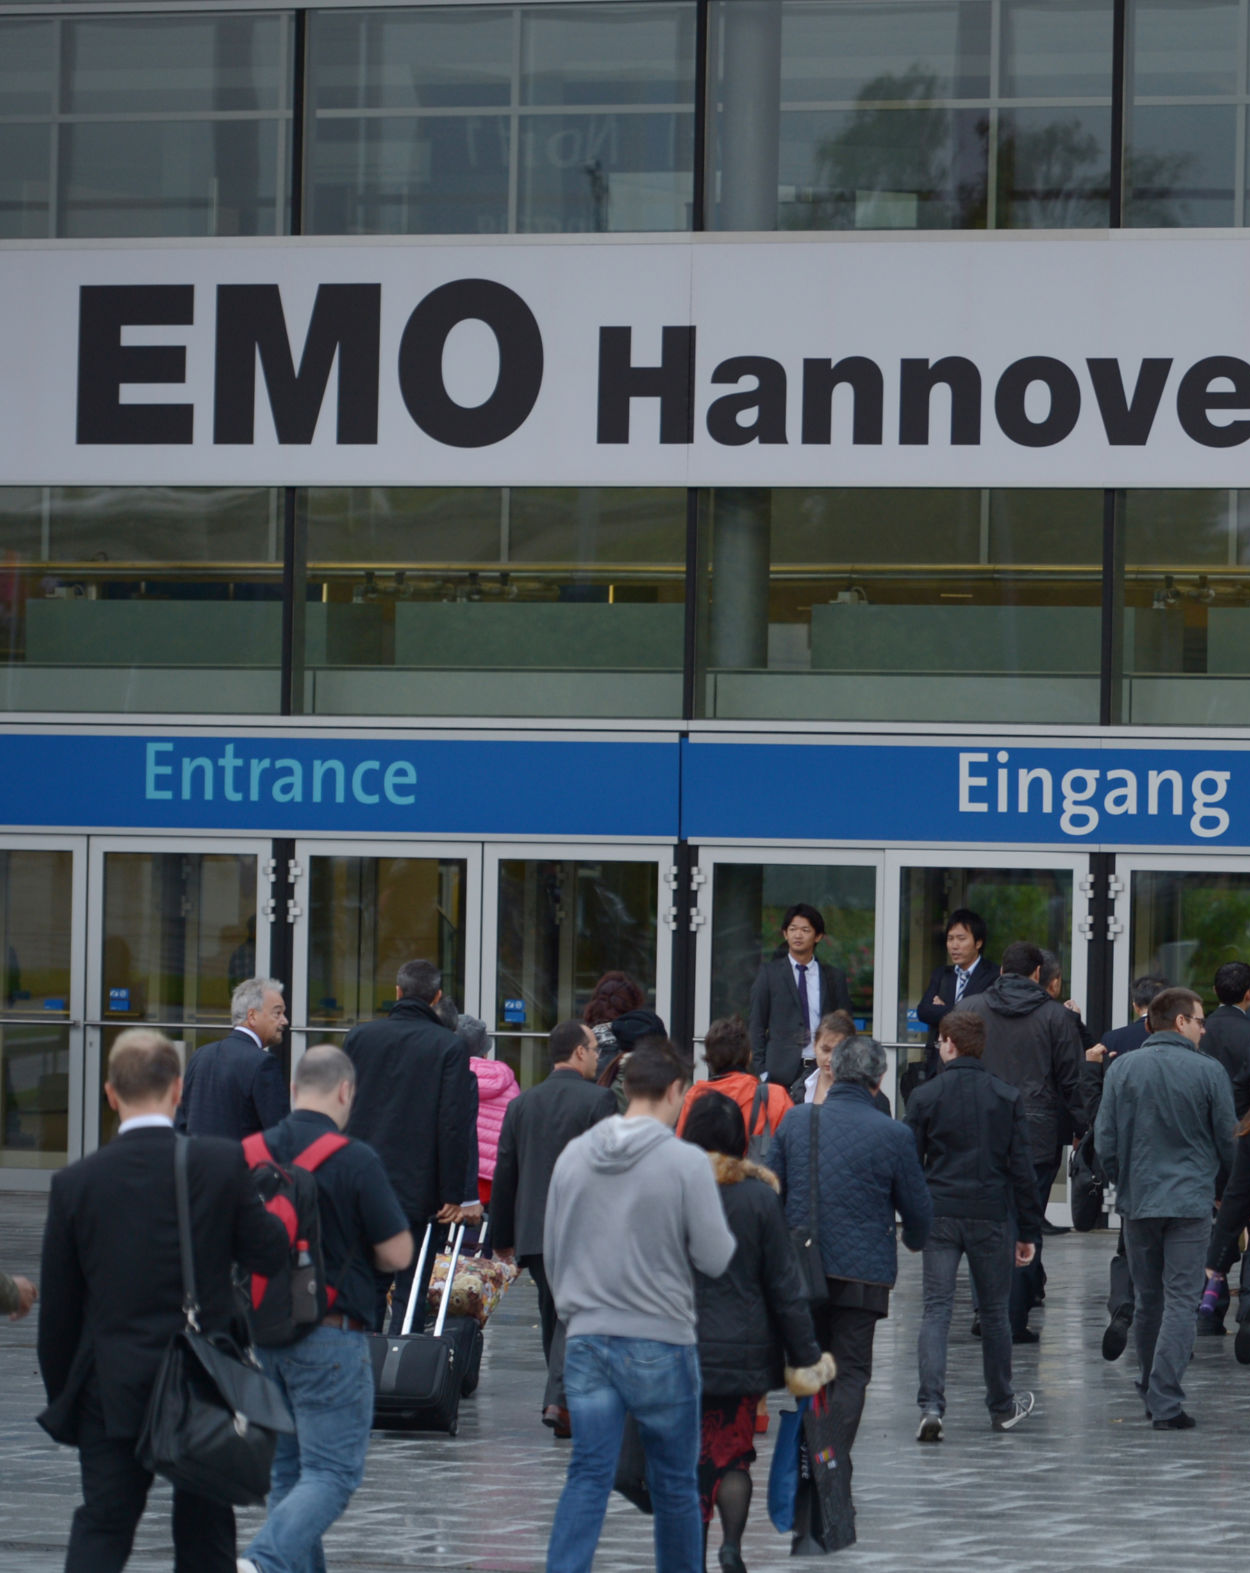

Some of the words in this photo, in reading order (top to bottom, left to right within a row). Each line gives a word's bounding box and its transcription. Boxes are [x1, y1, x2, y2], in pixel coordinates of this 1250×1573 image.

[76, 278, 544, 448] EMO
[145, 742, 418, 806] Entrance
[957, 751, 1232, 838] Eingang
